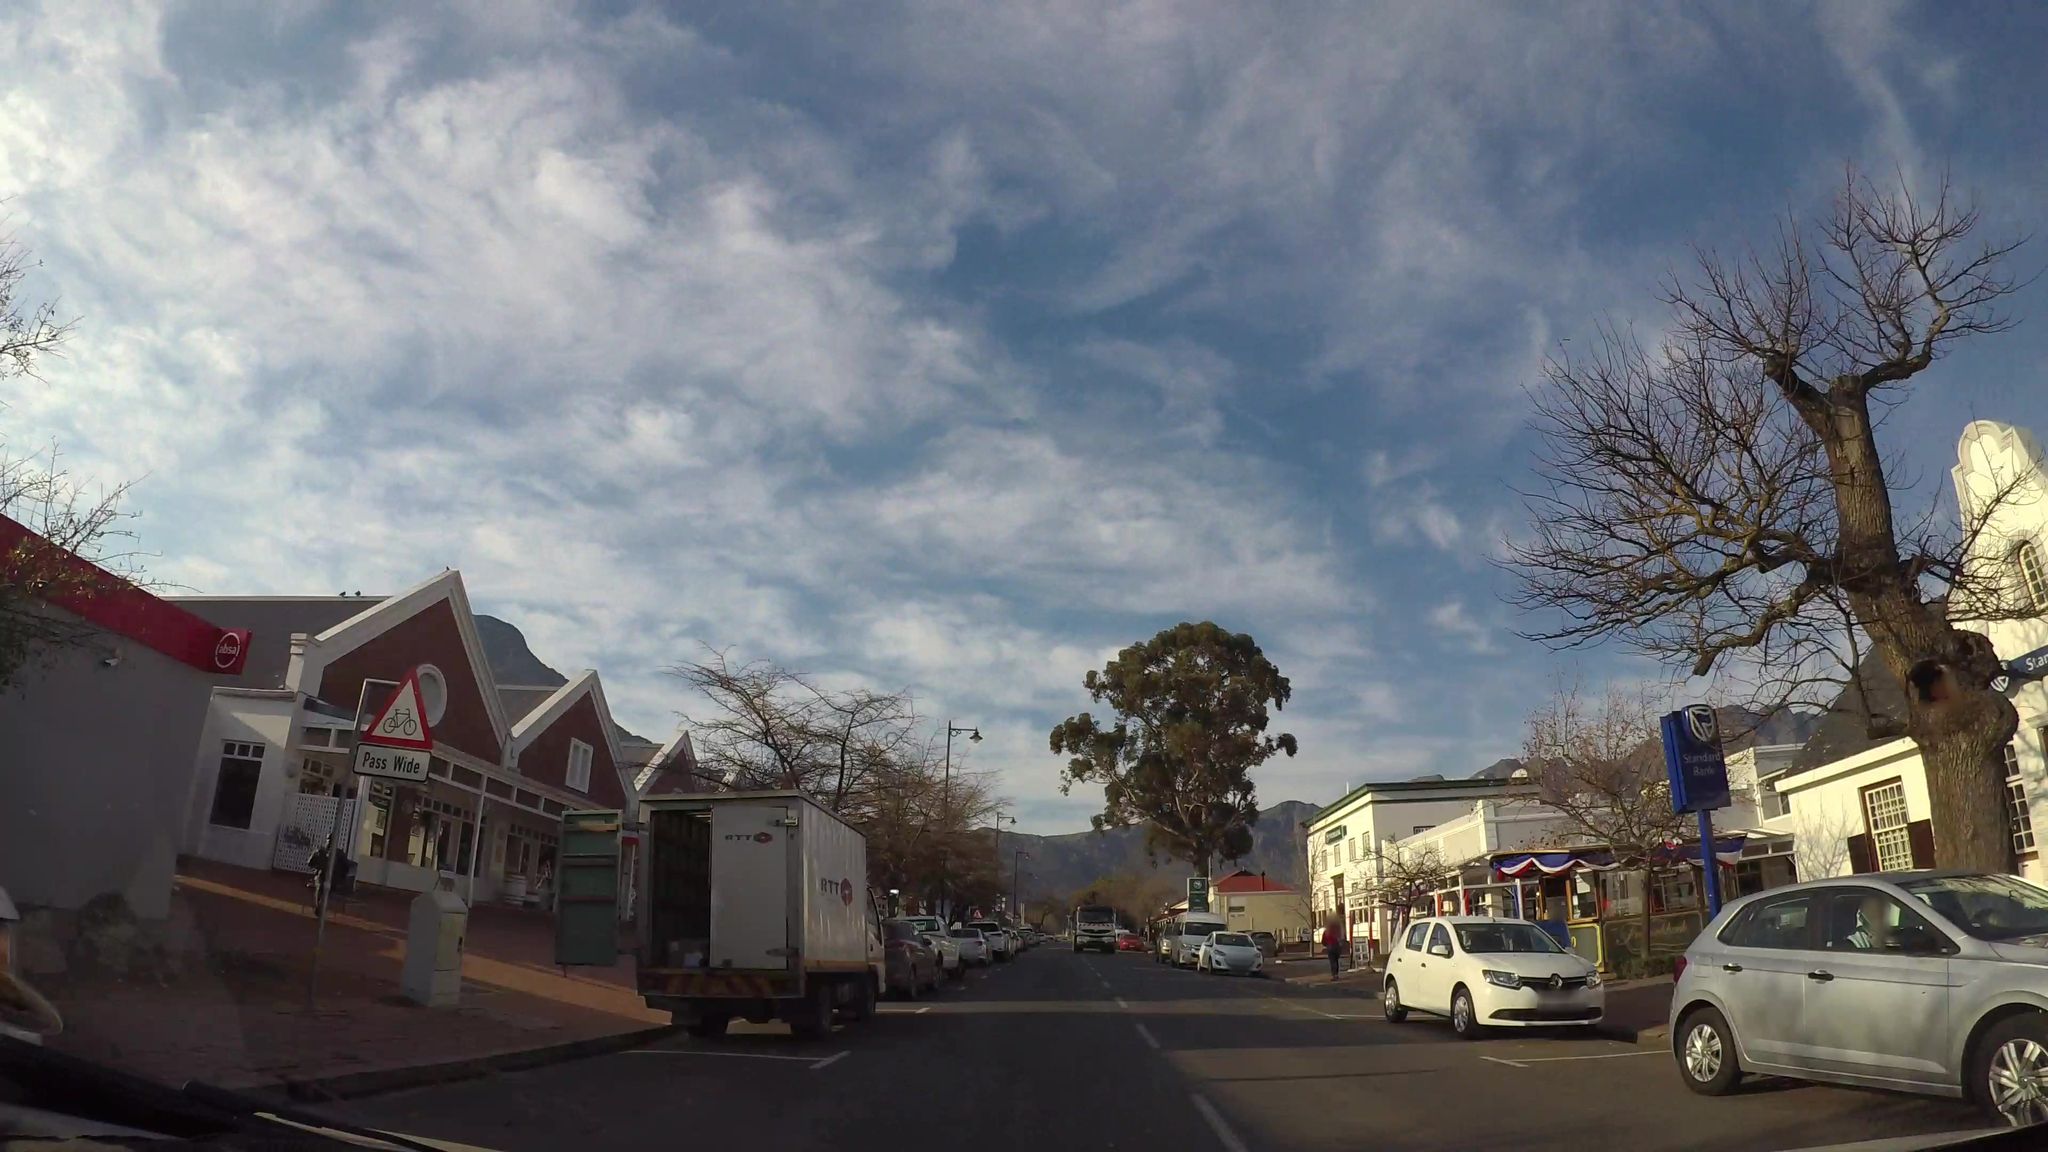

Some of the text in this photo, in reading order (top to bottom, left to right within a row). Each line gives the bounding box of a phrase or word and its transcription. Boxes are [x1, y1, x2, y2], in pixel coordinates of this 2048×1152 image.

[362, 751, 420, 774] Pass Wide
[1682, 752, 1721, 763] Standard
[1693, 766, 1715, 776] Bank
[820, 877, 840, 895] RTT
